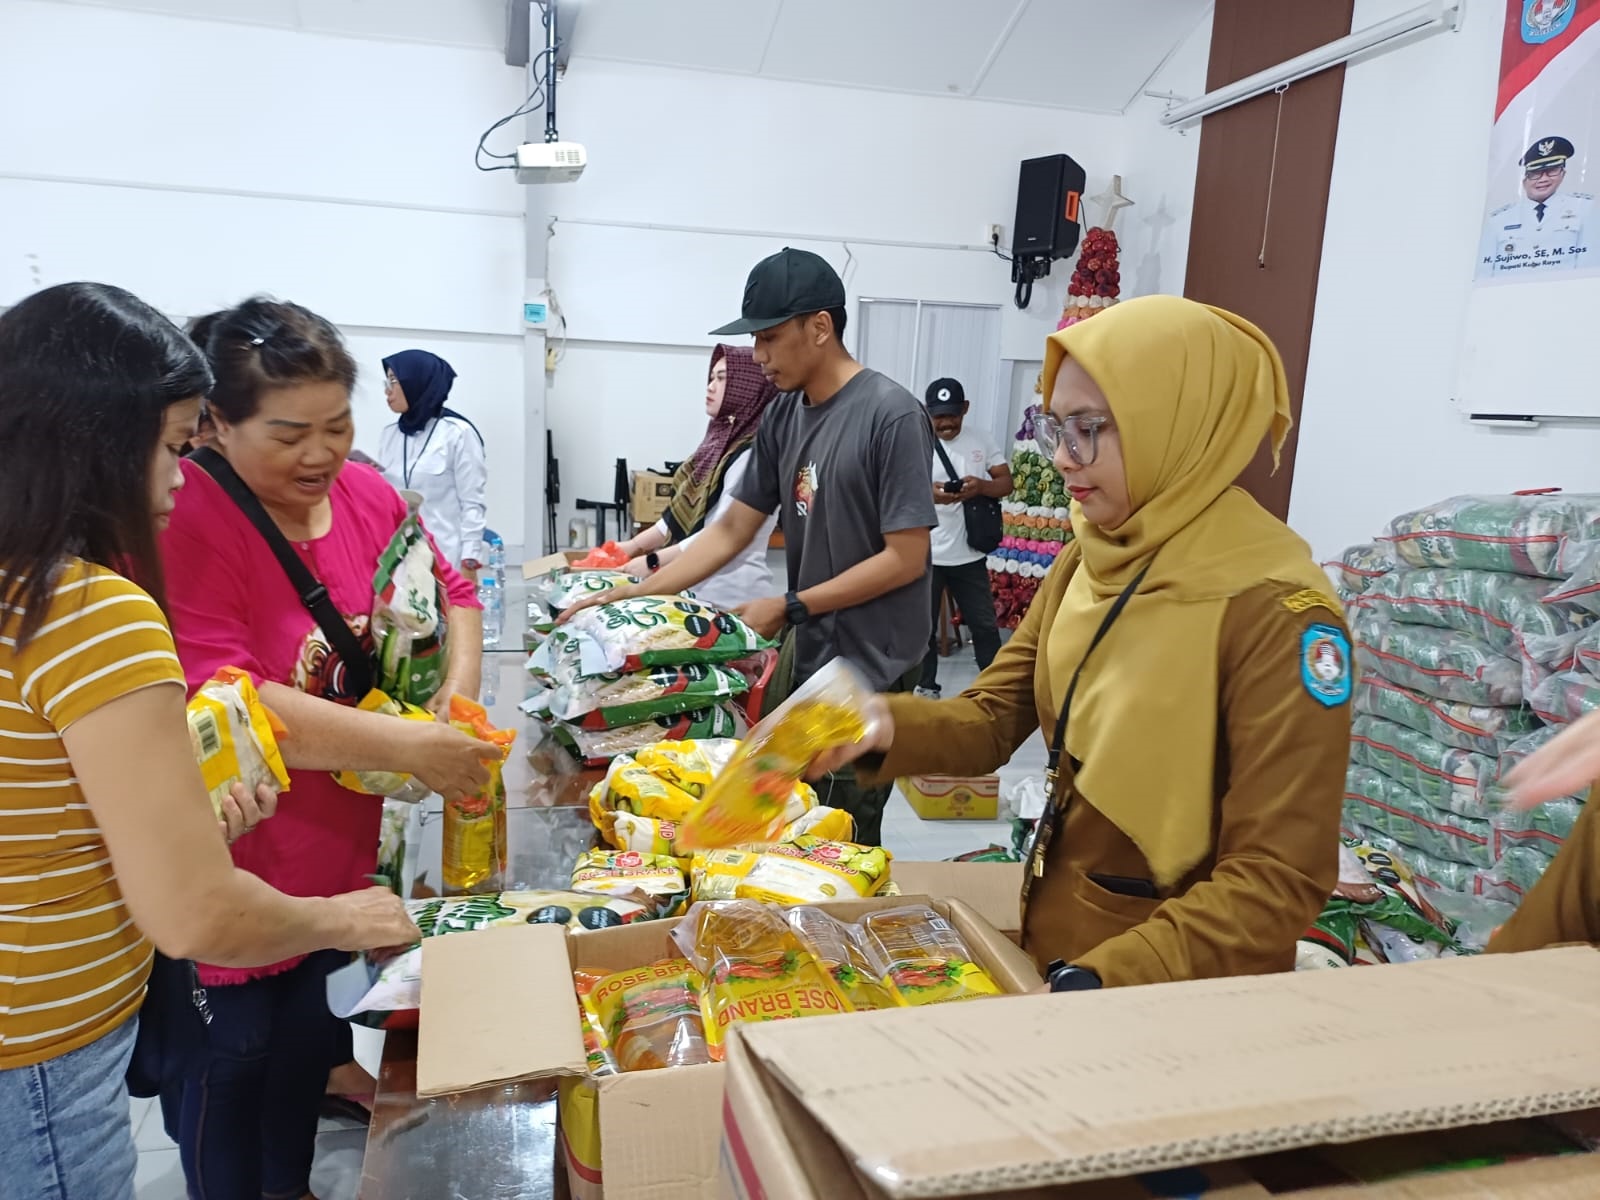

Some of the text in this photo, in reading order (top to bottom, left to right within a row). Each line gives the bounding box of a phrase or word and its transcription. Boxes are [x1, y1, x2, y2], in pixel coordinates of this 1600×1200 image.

[1494, 254, 1531, 263] Sujiwo,
[1534, 249, 1550, 258] SE,
[1552, 247, 1565, 256] M.
[1568, 246, 1587, 255] Sos
[1500, 262, 1521, 270] Bupati
[596, 961, 696, 1003] ROSE BRA
[718, 992, 793, 1027] BRAND
[795, 988, 841, 1011] OSE
